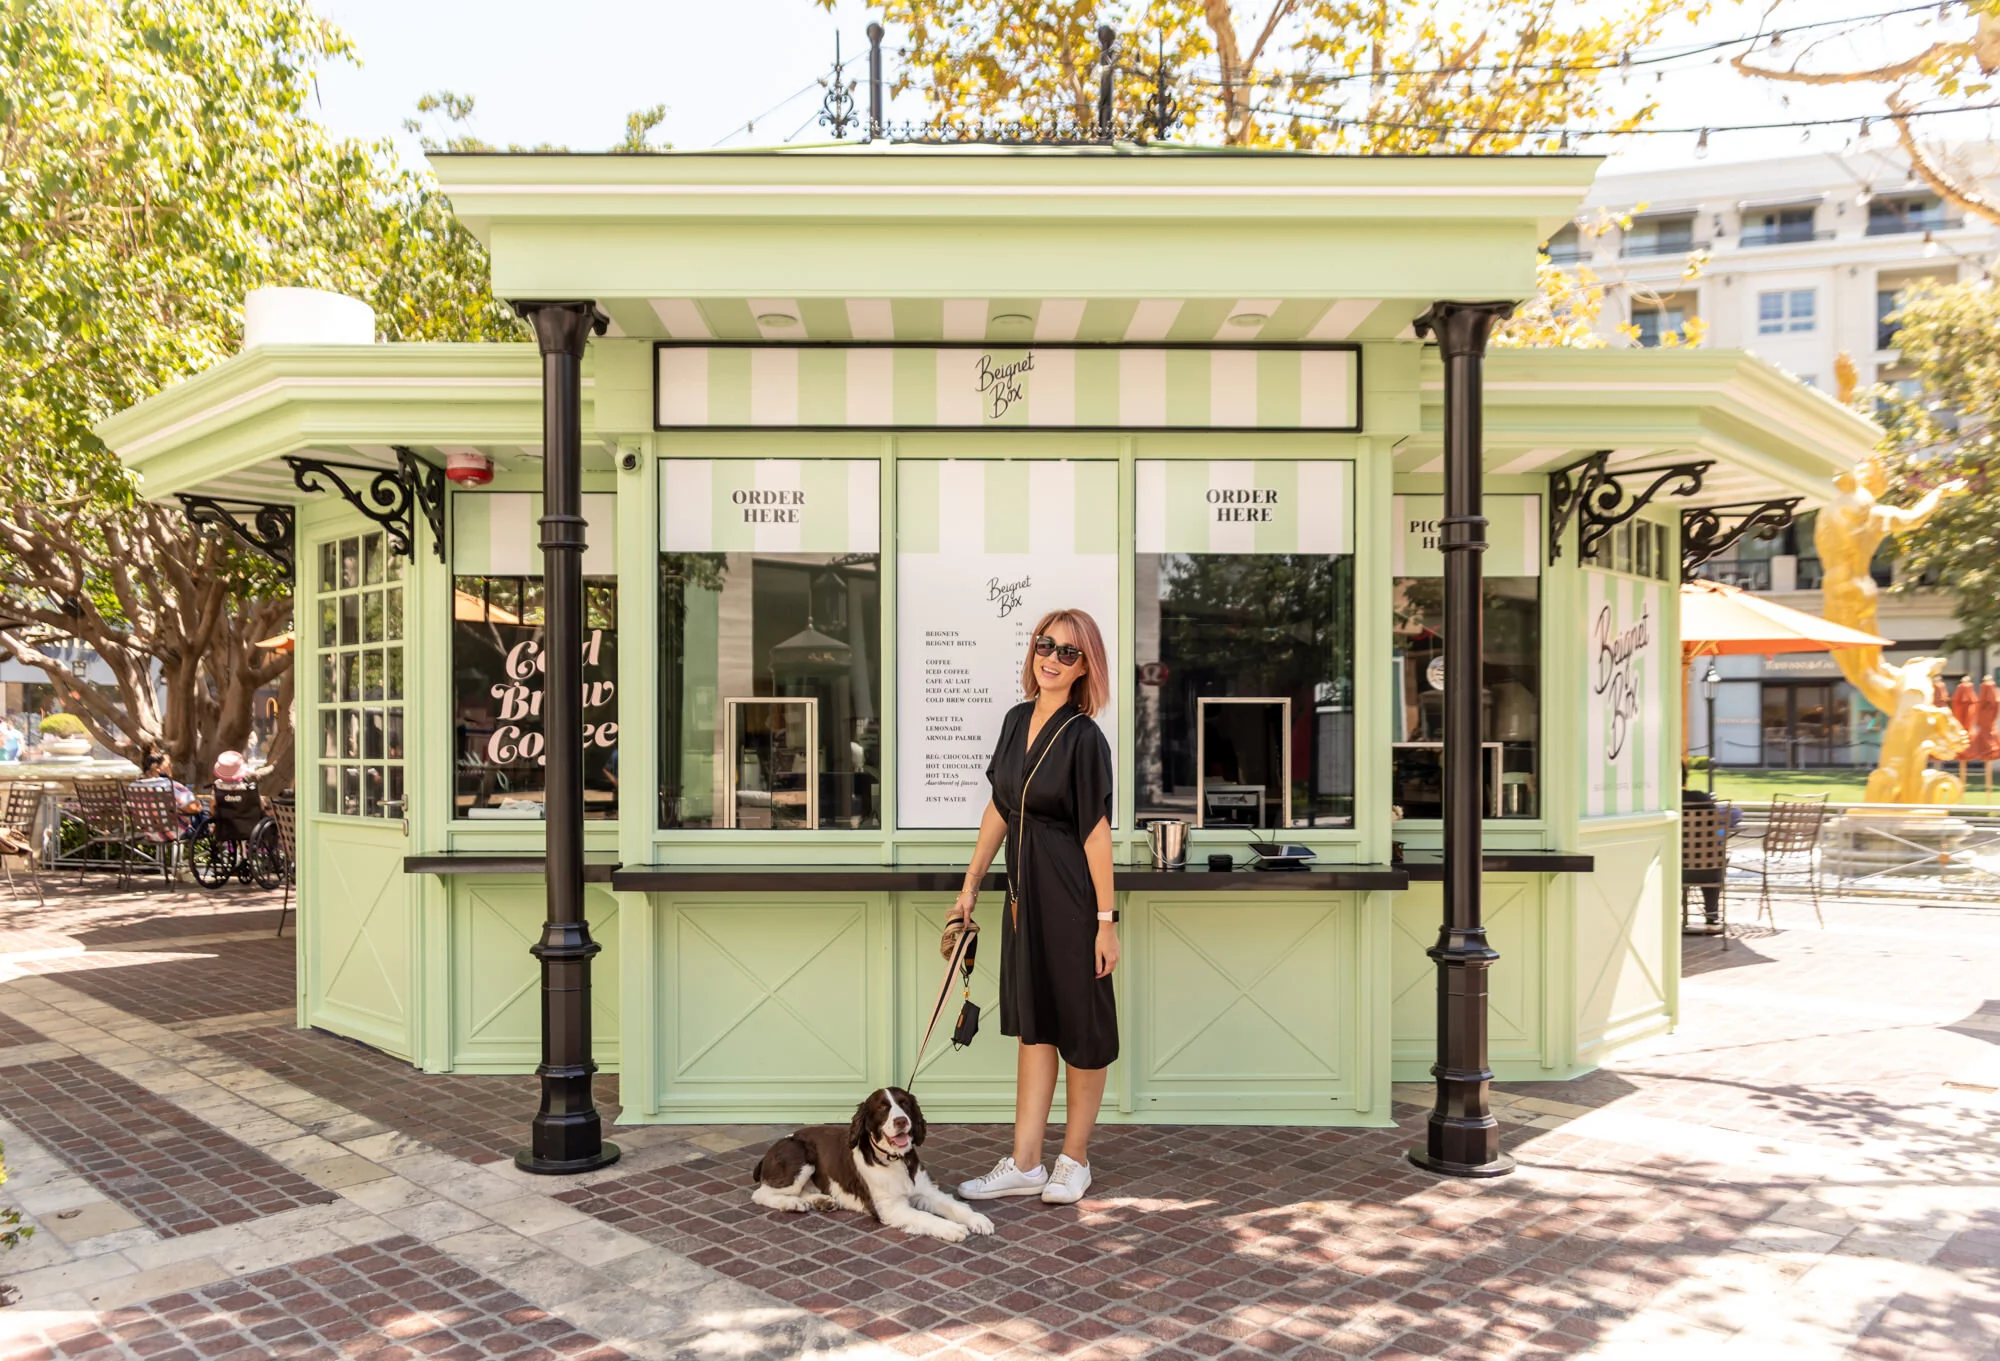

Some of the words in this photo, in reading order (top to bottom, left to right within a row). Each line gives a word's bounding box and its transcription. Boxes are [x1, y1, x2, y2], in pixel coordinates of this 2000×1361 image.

[975, 351, 1035, 392] Beignet
[988, 381, 1023, 419] Box
[732, 490, 805, 505] ORDER
[1206, 489, 1278, 504] ORDER
[743, 508, 800, 523] HERE
[1217, 507, 1273, 522] HERE
[1409, 520, 1442, 533] PIC
[986, 575, 1032, 602] Beignet
[996, 593, 1023, 618] Box
[1594, 603, 1650, 695] Beignet
[491, 681, 615, 721] Brw
[1608, 671, 1639, 761] Box
[488, 721, 619, 766] Coee
